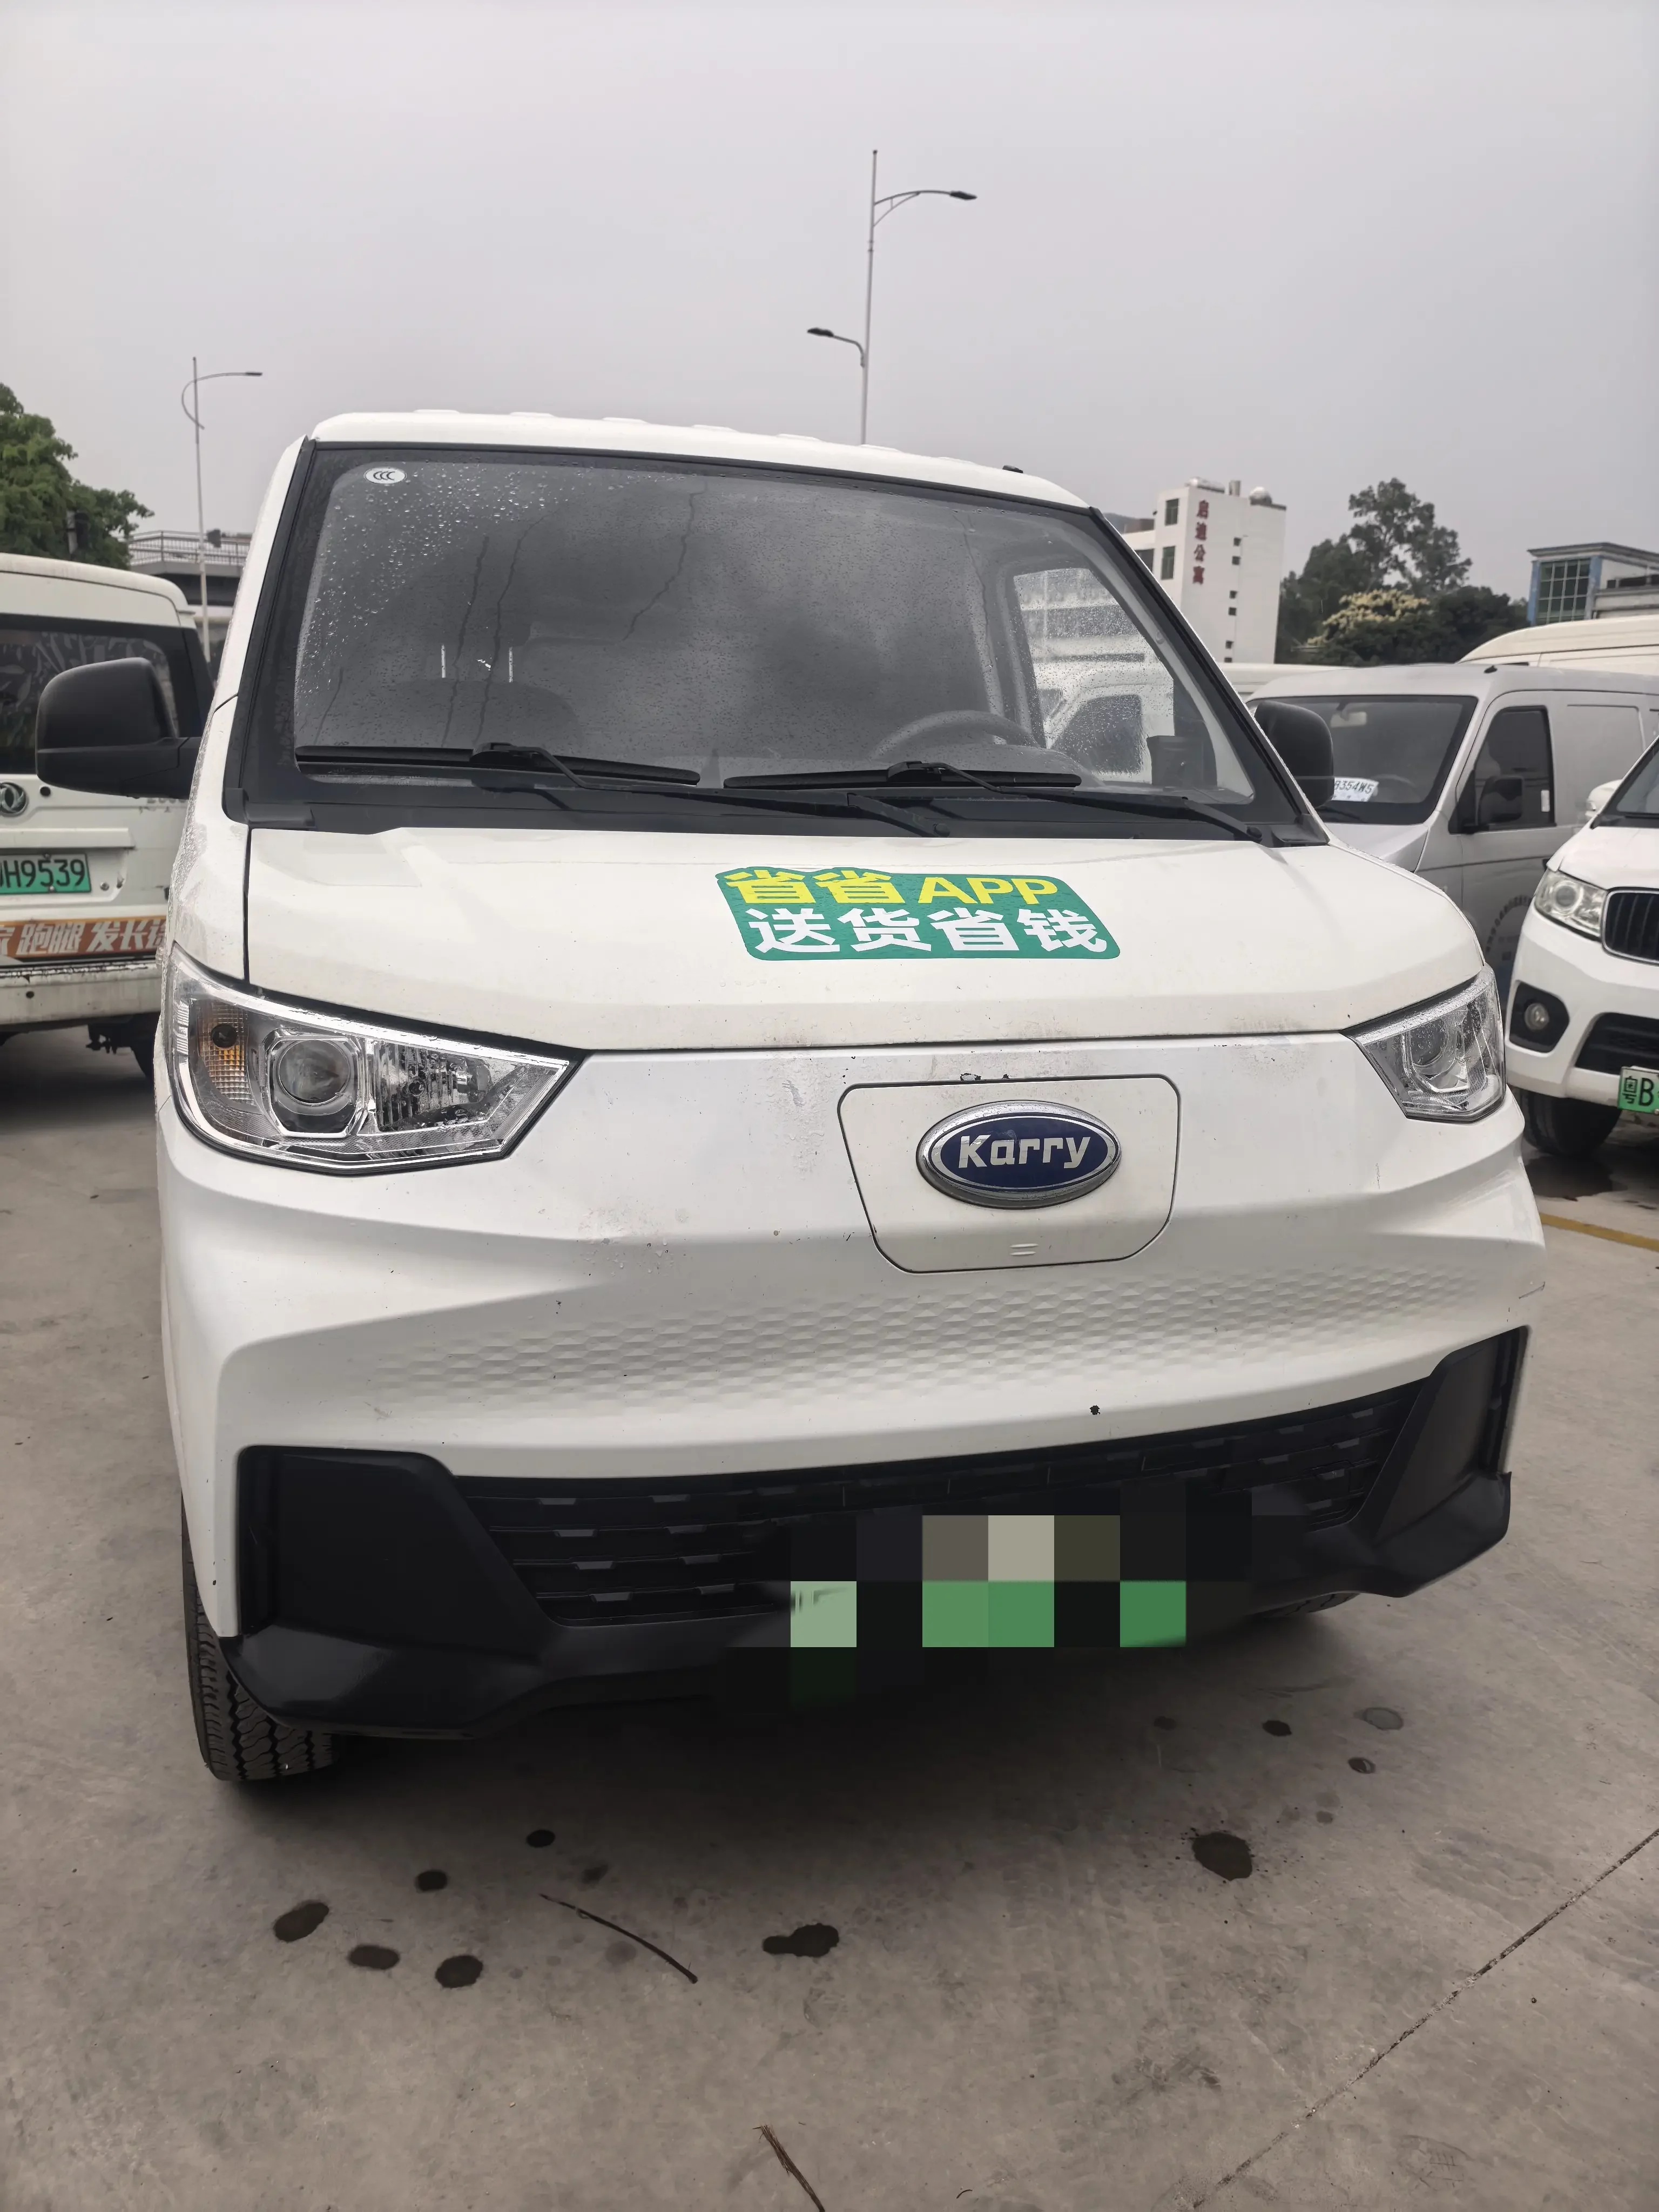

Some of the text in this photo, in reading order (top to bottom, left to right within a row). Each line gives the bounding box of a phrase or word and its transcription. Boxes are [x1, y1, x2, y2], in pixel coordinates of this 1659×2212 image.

[0, 859, 85, 888] H9539
[745, 907, 1107, 953] 送货省钱
[958, 1134, 1091, 1169] Karry
